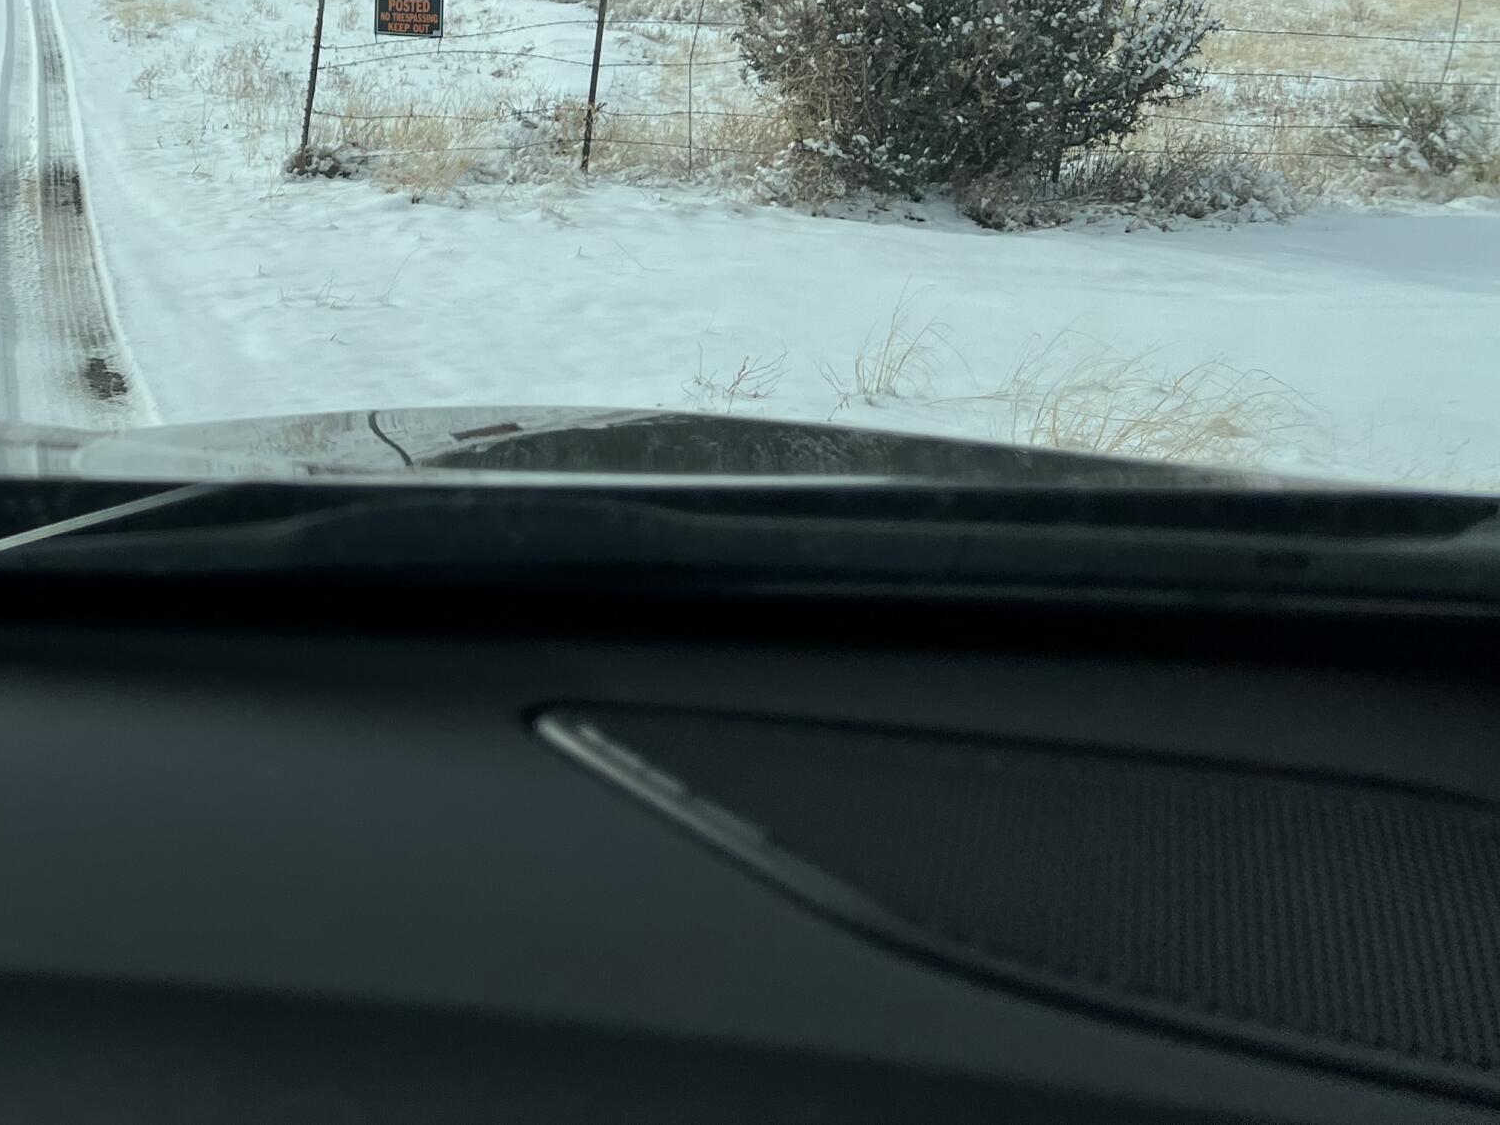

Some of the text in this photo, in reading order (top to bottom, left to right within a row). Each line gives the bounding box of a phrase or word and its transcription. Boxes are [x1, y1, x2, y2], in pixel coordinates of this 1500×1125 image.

[380, 12, 438, 23] NO TRESPASSING
[388, 23, 429, 33] KEEP OUT
